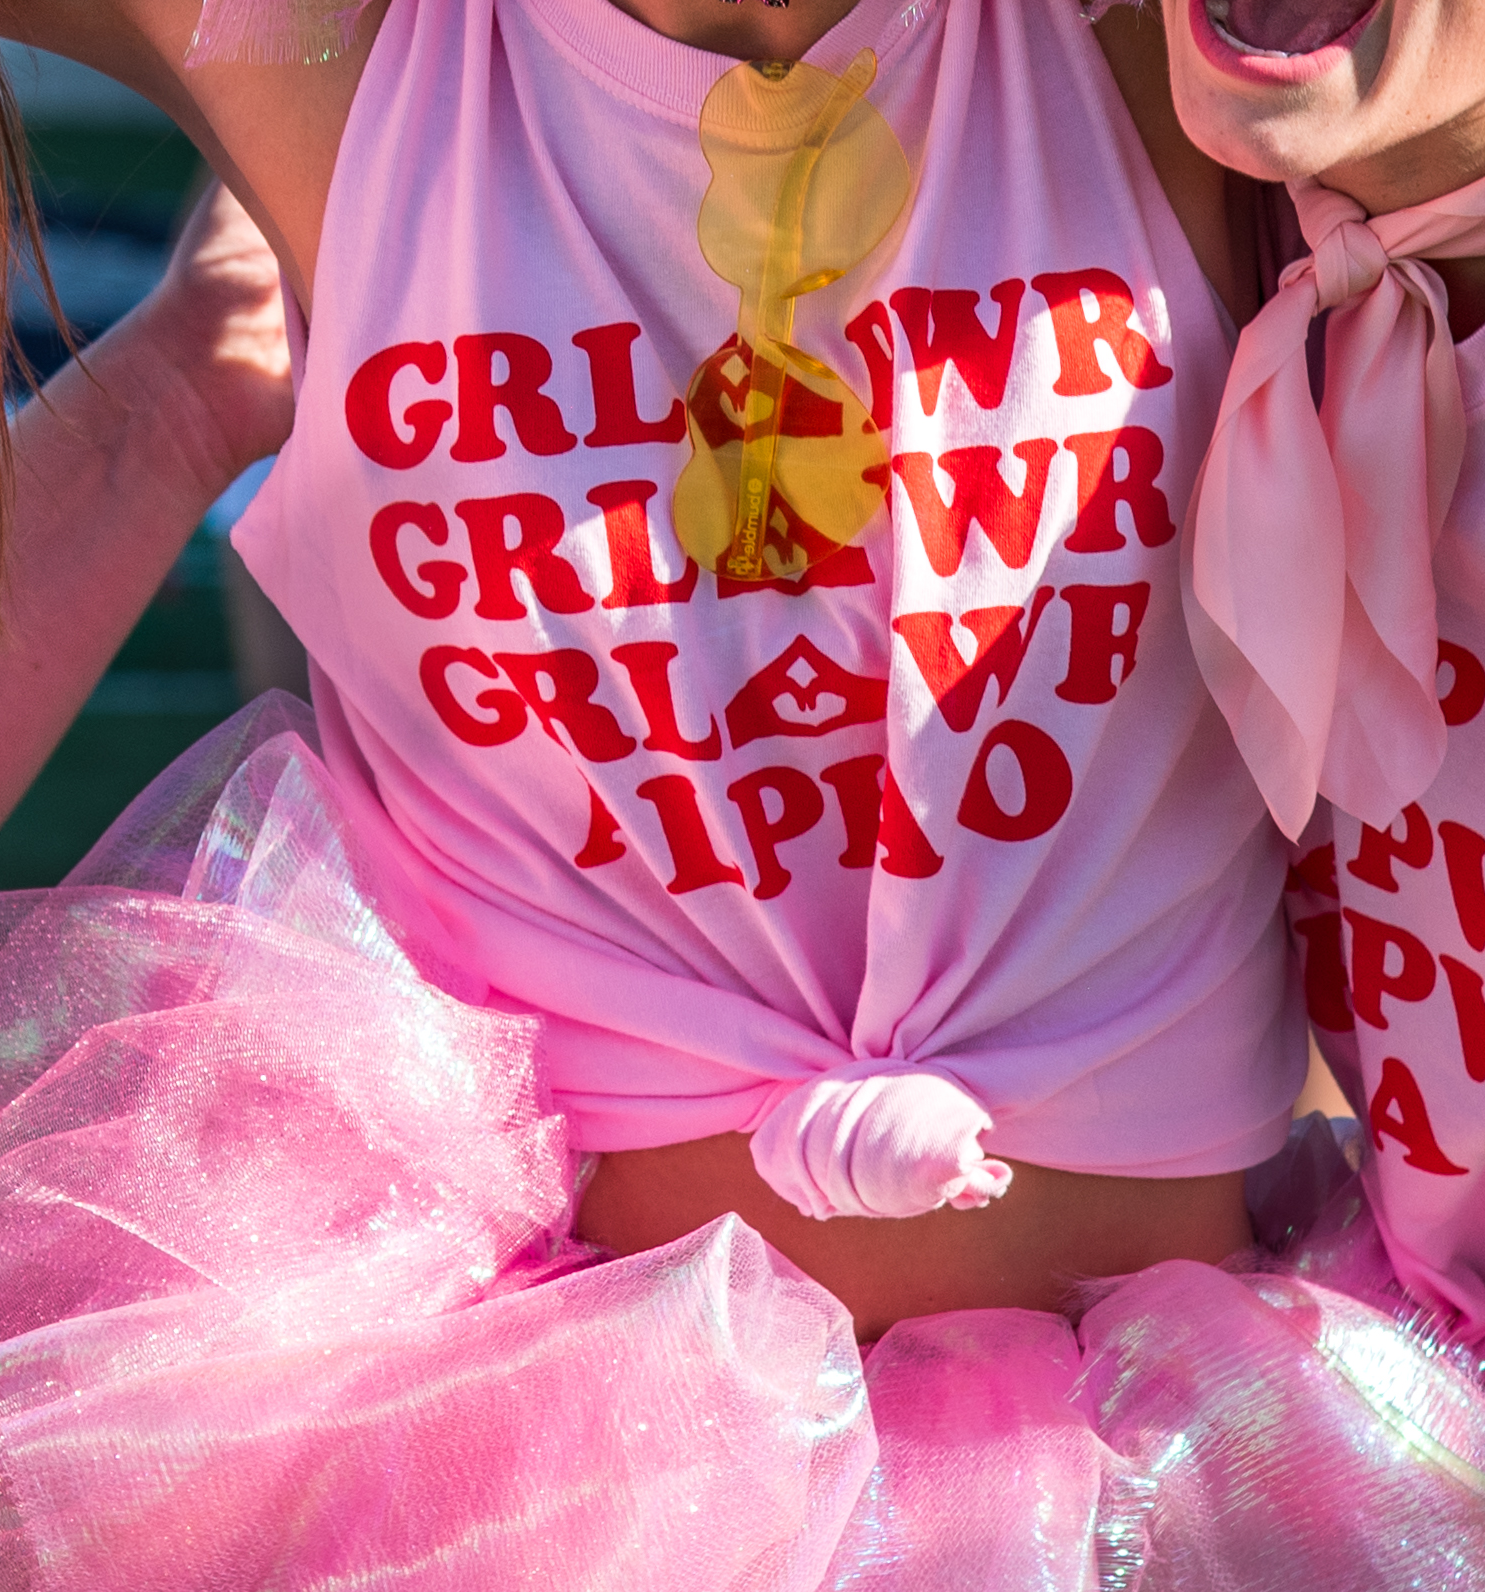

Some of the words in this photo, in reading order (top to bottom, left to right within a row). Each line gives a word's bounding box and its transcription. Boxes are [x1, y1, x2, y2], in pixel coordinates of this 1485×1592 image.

[344, 321, 688, 470] GRL
[369, 479, 696, 621] GRL
[862, 425, 1177, 578] WR
[419, 640, 723, 763] GRL
[956, 718, 1074, 843] O
